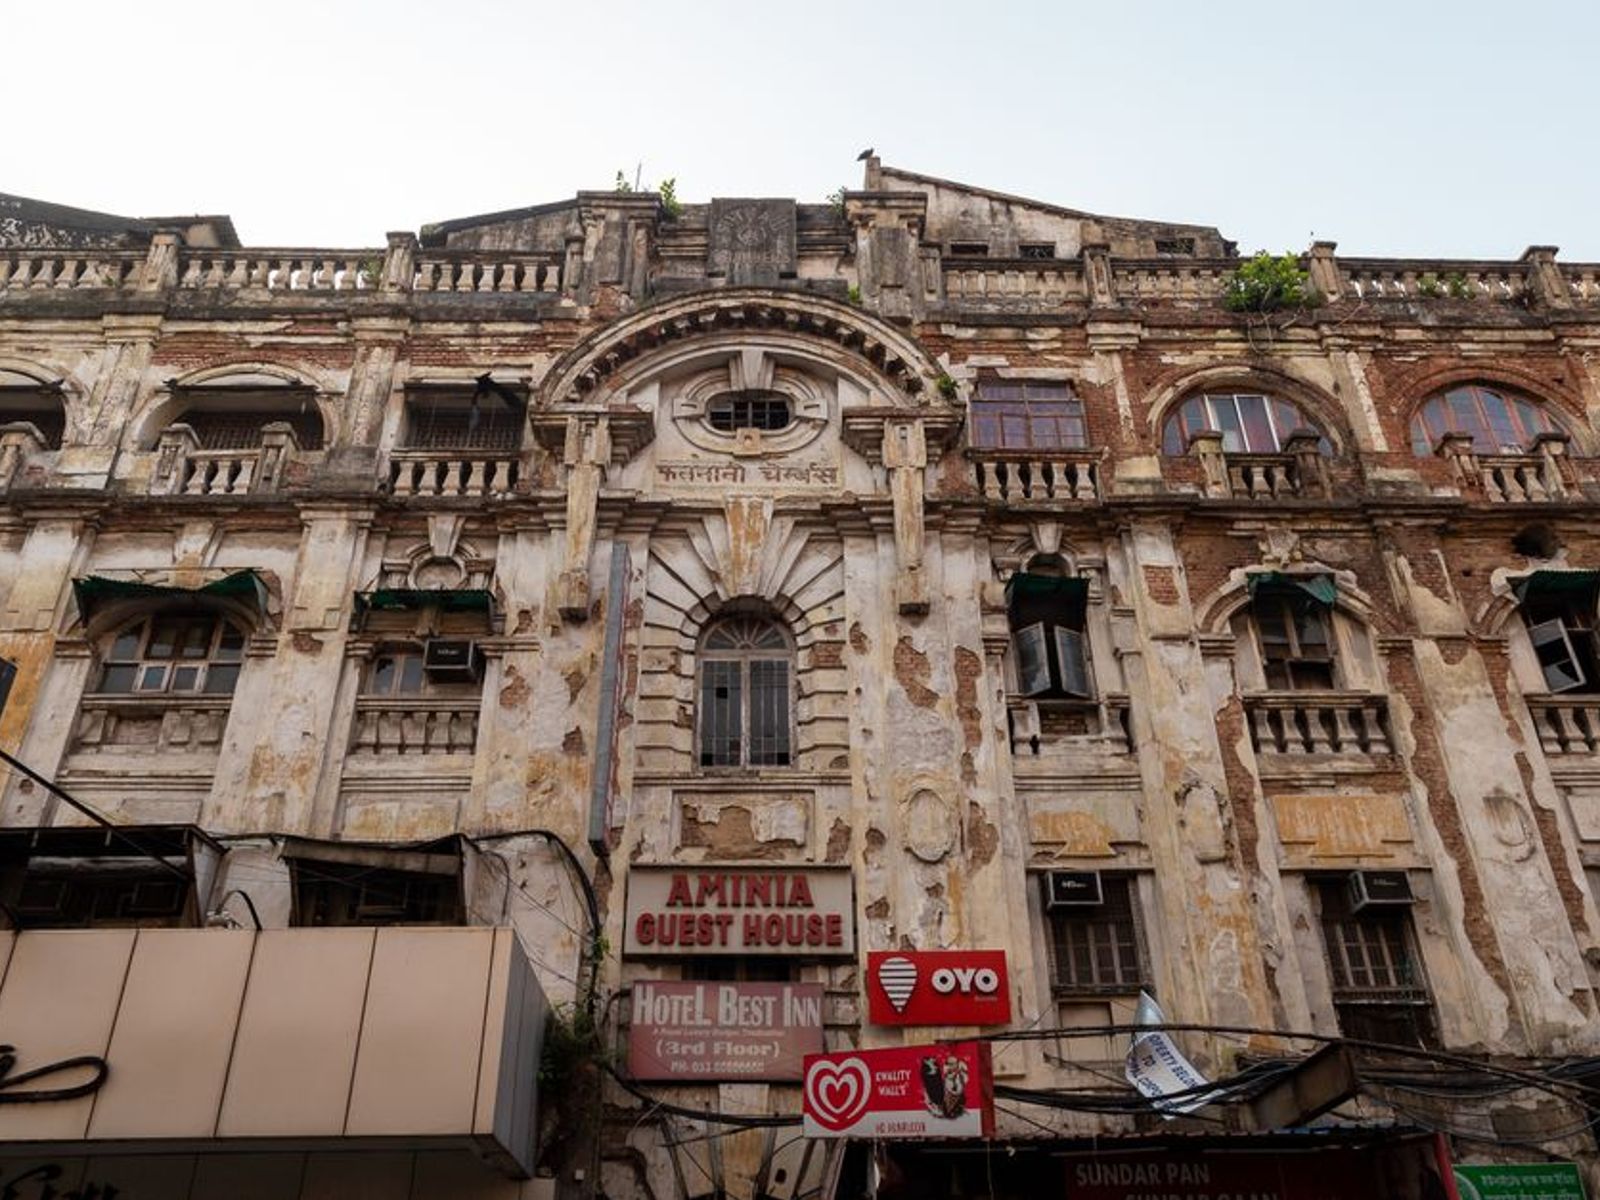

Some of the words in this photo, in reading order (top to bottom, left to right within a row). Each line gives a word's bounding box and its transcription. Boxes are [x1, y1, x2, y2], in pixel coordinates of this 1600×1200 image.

[666, 873, 814, 907] AMINIA
[635, 913, 734, 946] GUEST
[742, 914, 843, 946] HOUSE
[931, 967, 998, 993] OYO
[633, 984, 712, 1025] HOTEL
[719, 985, 777, 1026] BEST
[783, 986, 821, 1026] INN
[655, 1039, 706, 1057] (3rd
[712, 1040, 781, 1058] Floor)
[876, 1069, 912, 1082] KWALITY
[1074, 1162, 1162, 1186] SUNDAR
[1165, 1162, 1210, 1185] PAN
